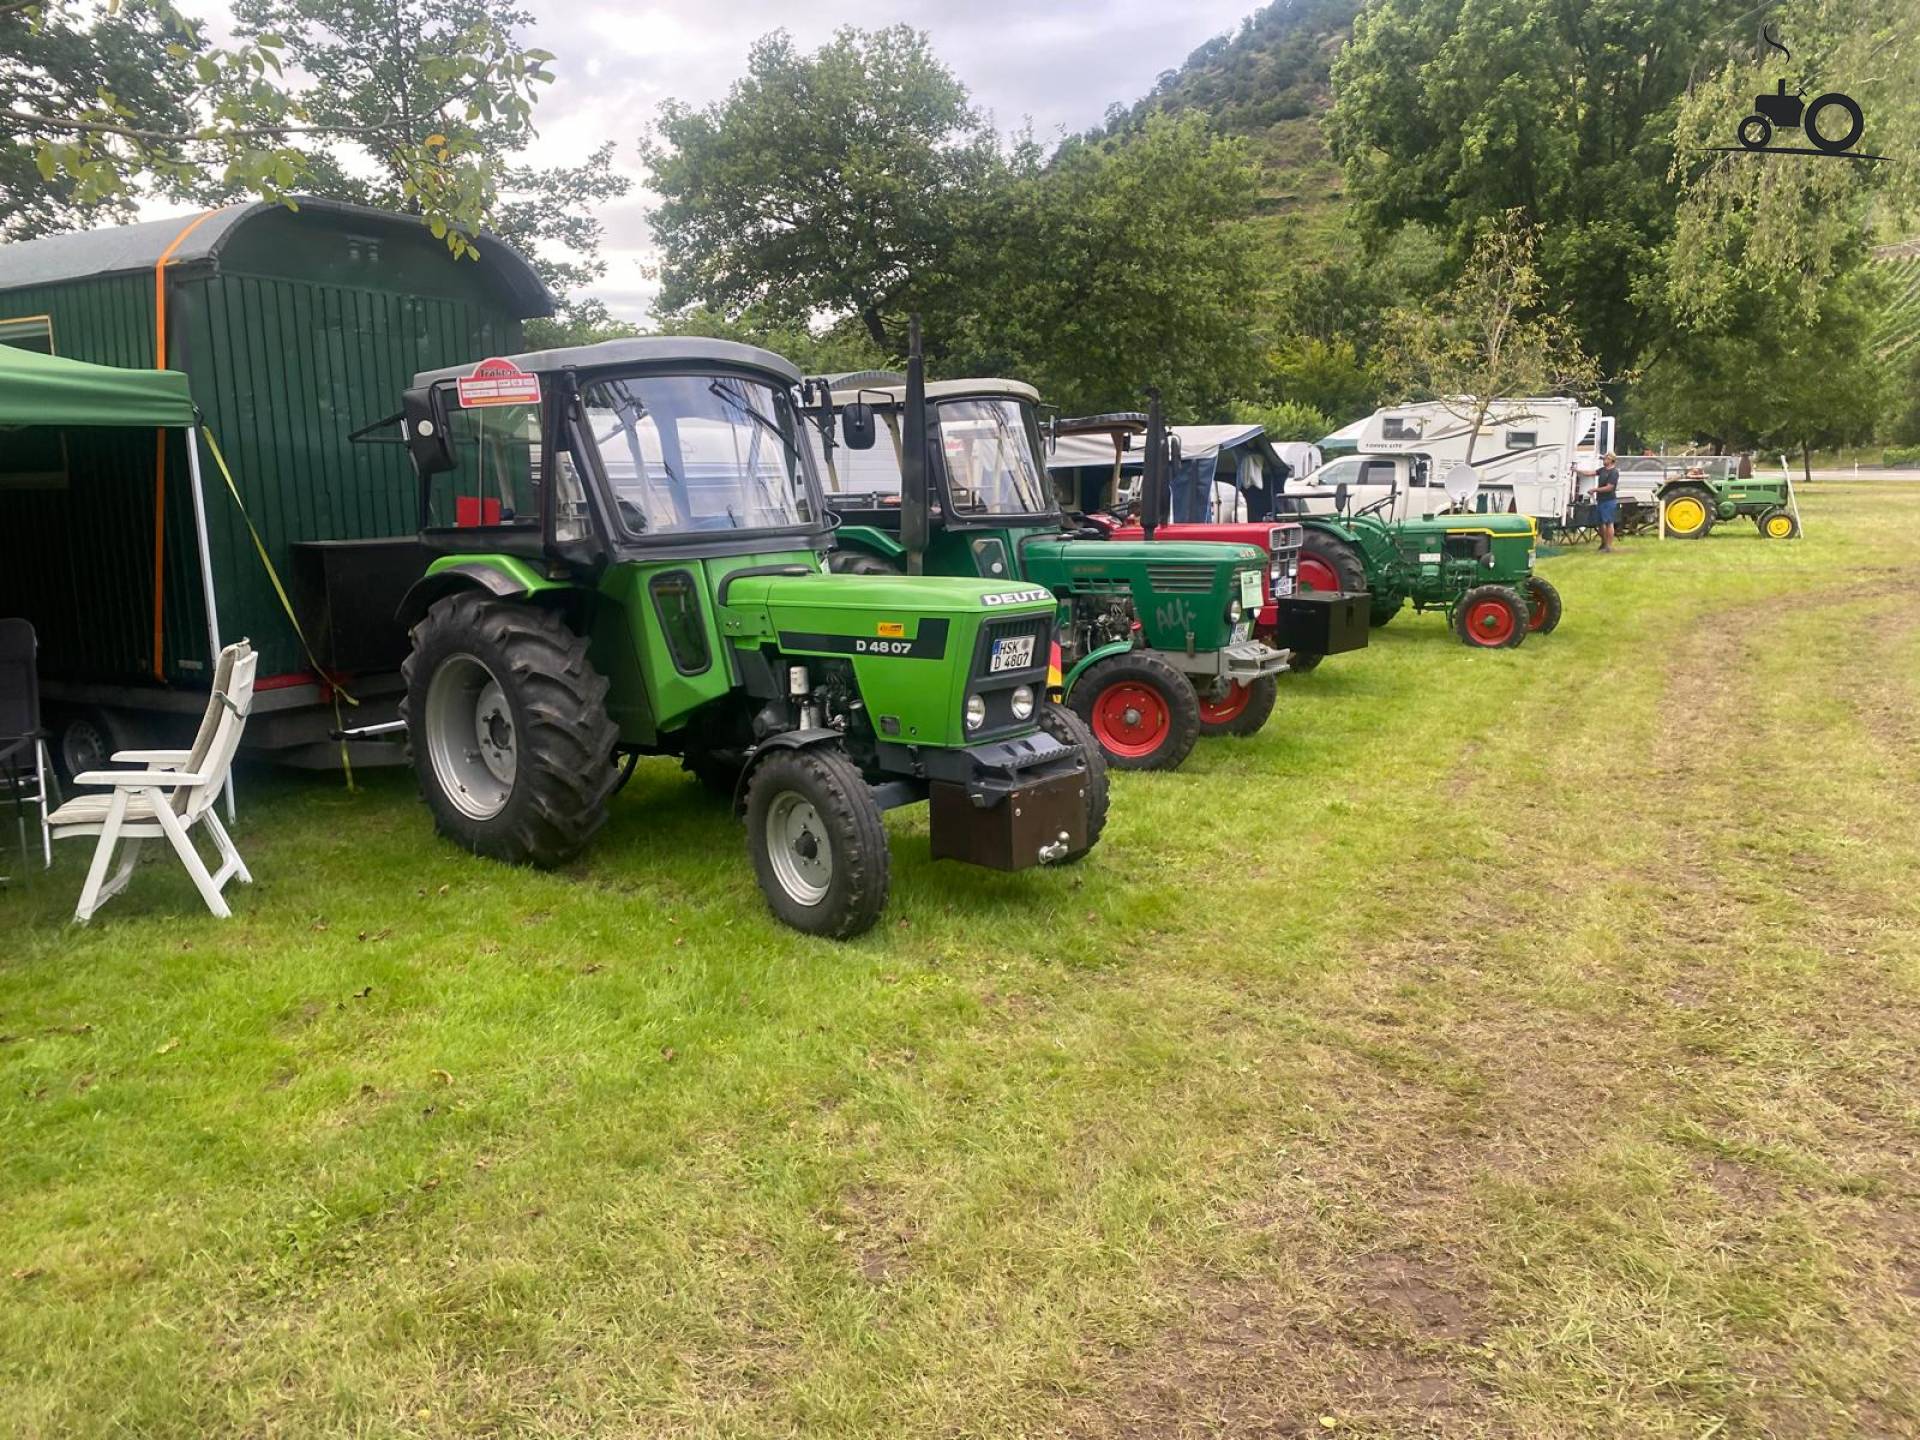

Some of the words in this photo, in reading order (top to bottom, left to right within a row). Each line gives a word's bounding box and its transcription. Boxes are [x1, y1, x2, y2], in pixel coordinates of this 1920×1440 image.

[983, 589, 1050, 606] DEUTZ
[856, 640, 866, 652] D
[869, 641, 912, 654] 4807
[1000, 641, 1020, 655] HSK
[994, 655, 1001, 669] D
[1004, 652, 1029, 668] 4807
